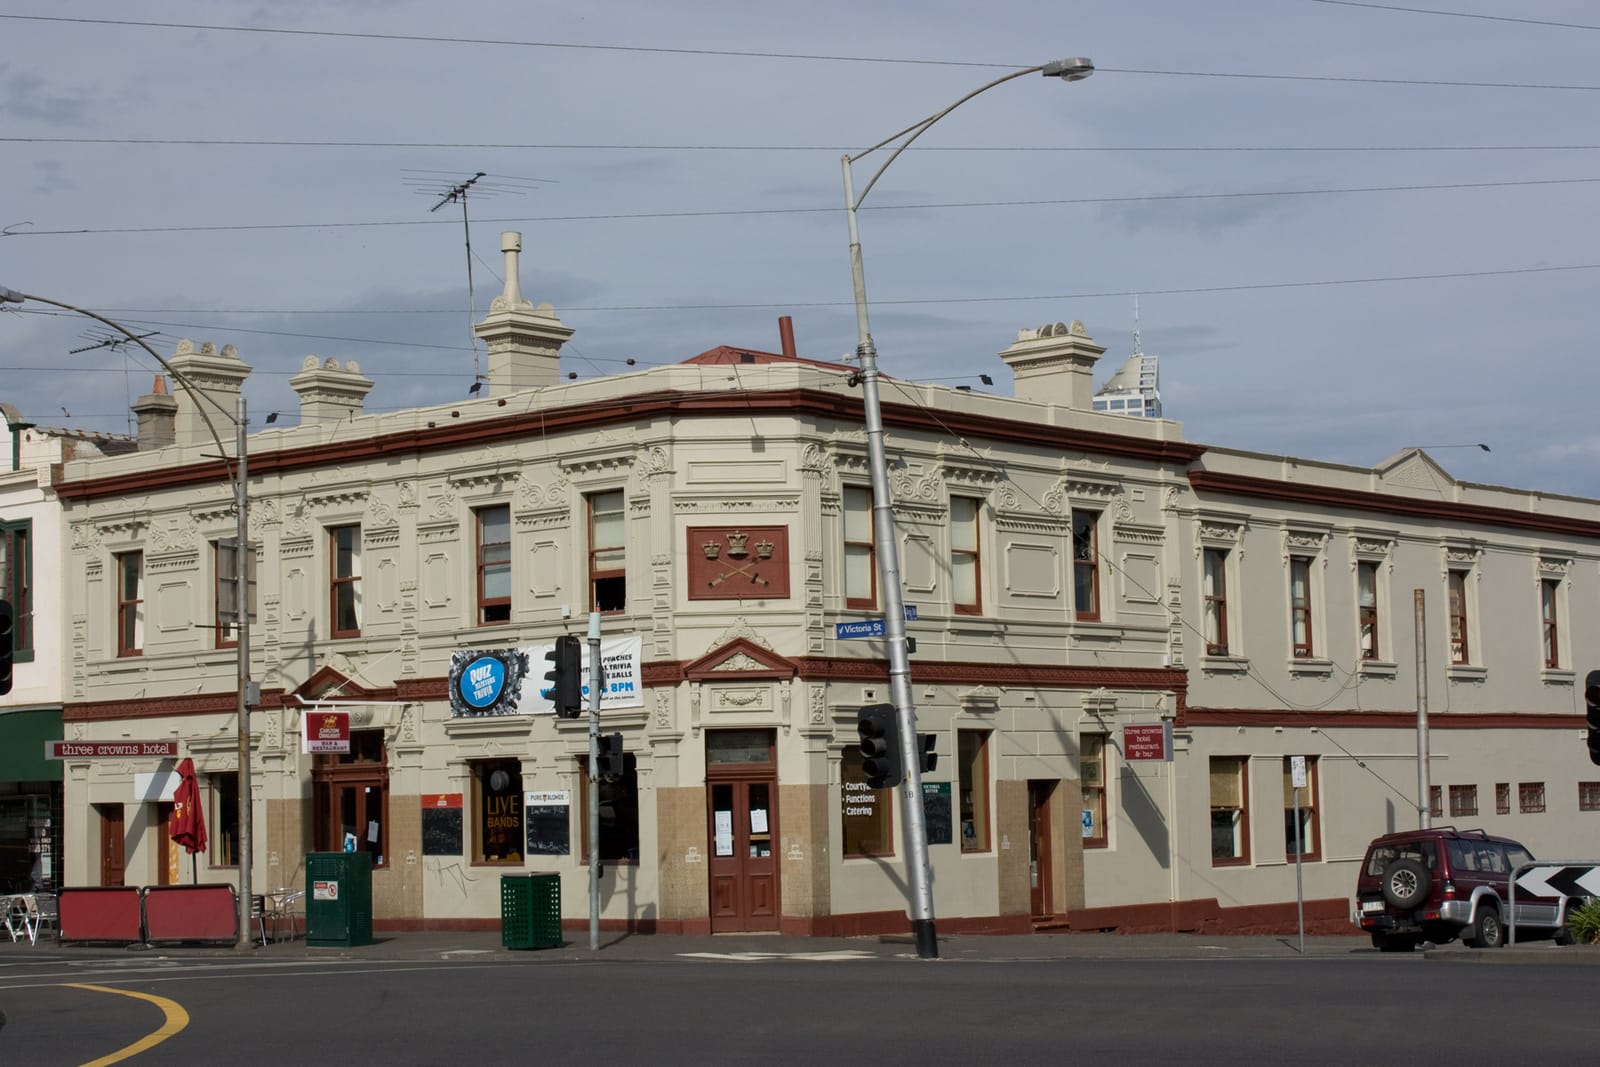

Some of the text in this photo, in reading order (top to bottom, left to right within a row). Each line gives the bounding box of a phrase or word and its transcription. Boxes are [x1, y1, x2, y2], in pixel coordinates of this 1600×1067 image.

[844, 623, 882, 633] Victoria St
[609, 662, 632, 670] TRIVIA
[470, 664, 492, 686] QUIZ
[611, 682, 634, 692] 8PM
[473, 685, 493, 701] TRIVIA
[62, 743, 170, 755] three crowns hotel
[845, 795, 876, 803] Functions
[487, 795, 519, 815] LIVE
[846, 807, 872, 816] Catering
[487, 817, 519, 828] BANDS
